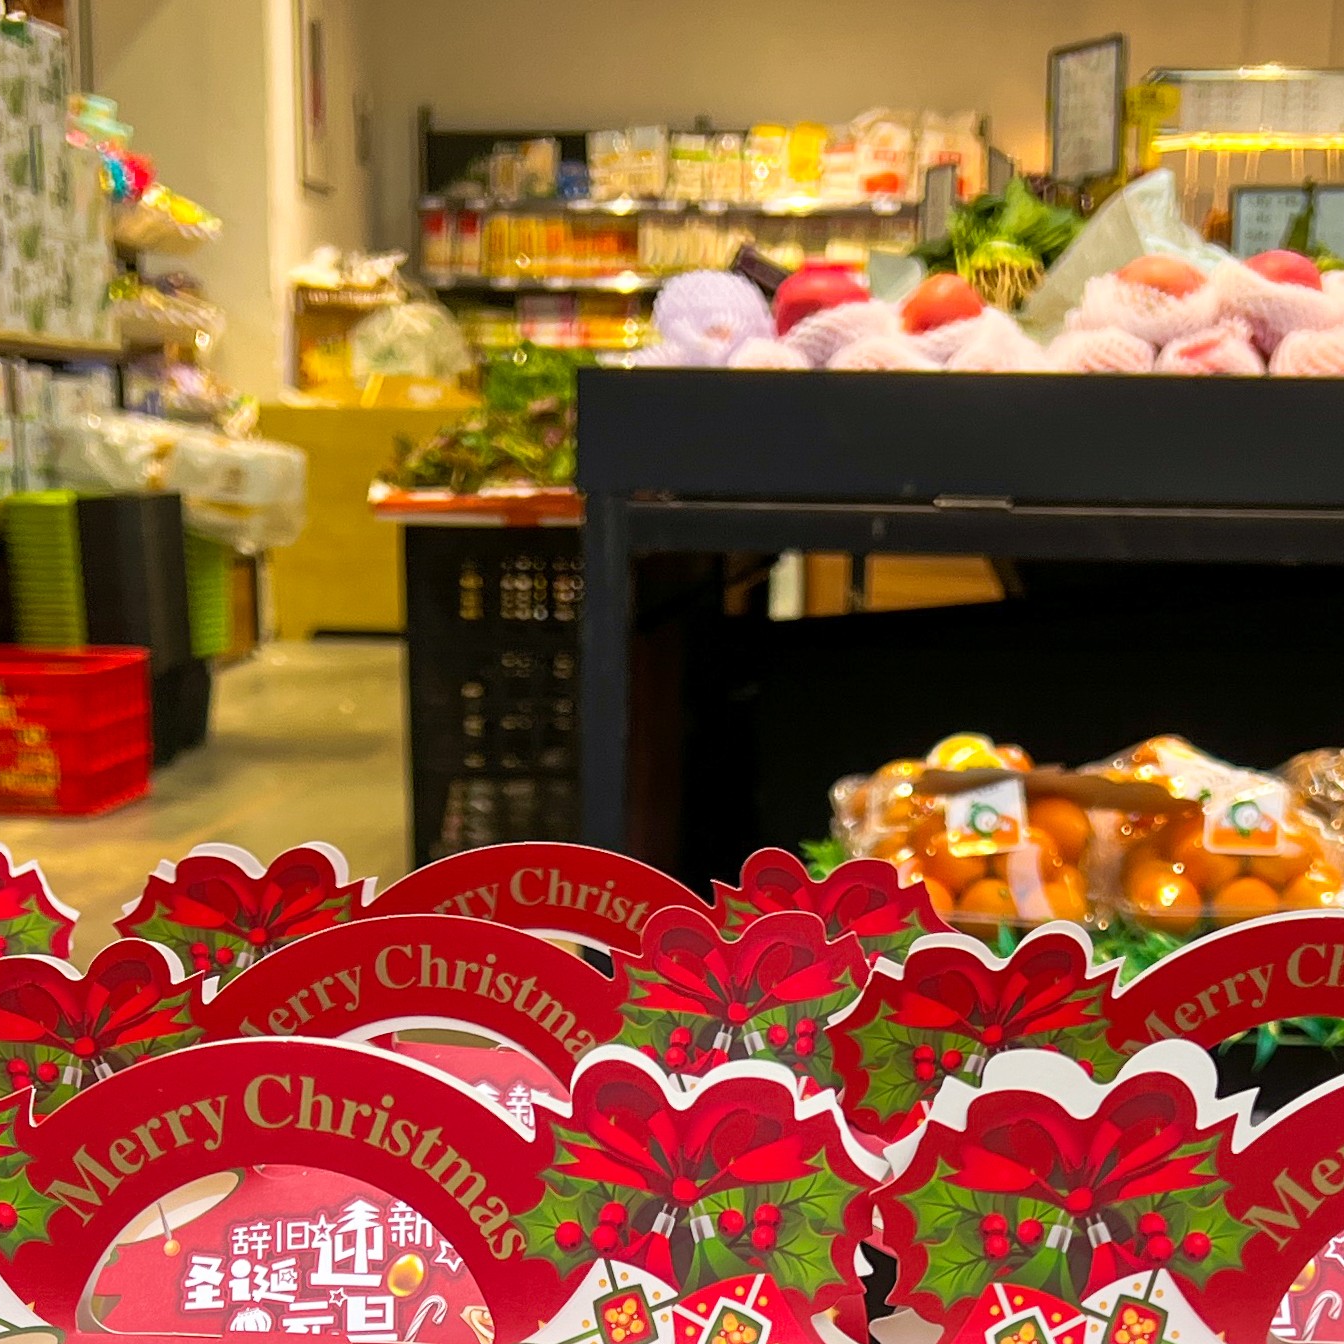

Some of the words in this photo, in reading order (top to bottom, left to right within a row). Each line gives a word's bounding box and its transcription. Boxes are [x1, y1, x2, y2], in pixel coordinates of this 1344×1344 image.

[509, 867, 651, 937] Christ
[375, 943, 598, 1063] Christma
[47, 1094, 229, 1227] Merry
[243, 1073, 527, 1261] Christmas
[184, 1256, 298, 1310] 圣诞
